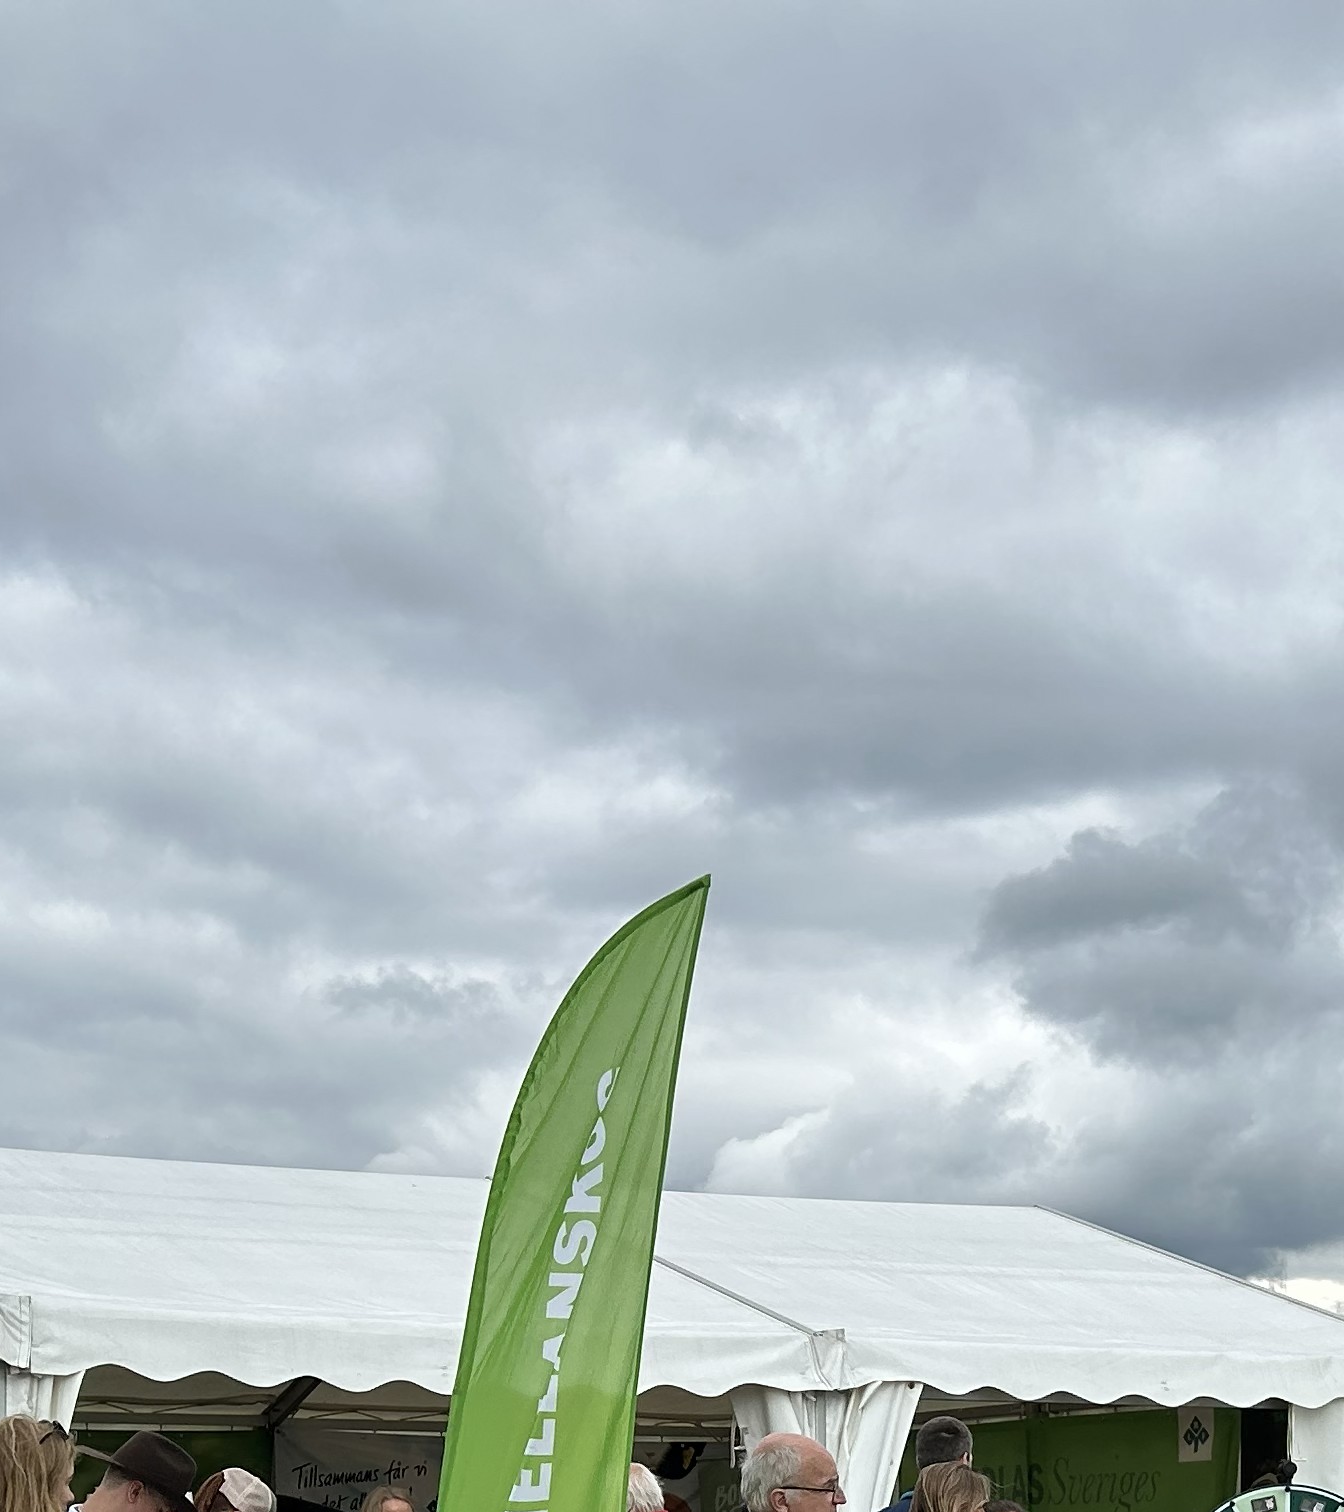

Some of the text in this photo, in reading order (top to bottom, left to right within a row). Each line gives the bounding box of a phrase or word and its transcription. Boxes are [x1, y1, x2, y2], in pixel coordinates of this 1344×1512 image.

[292, 1460, 428, 1490] Tillsammans får vi
